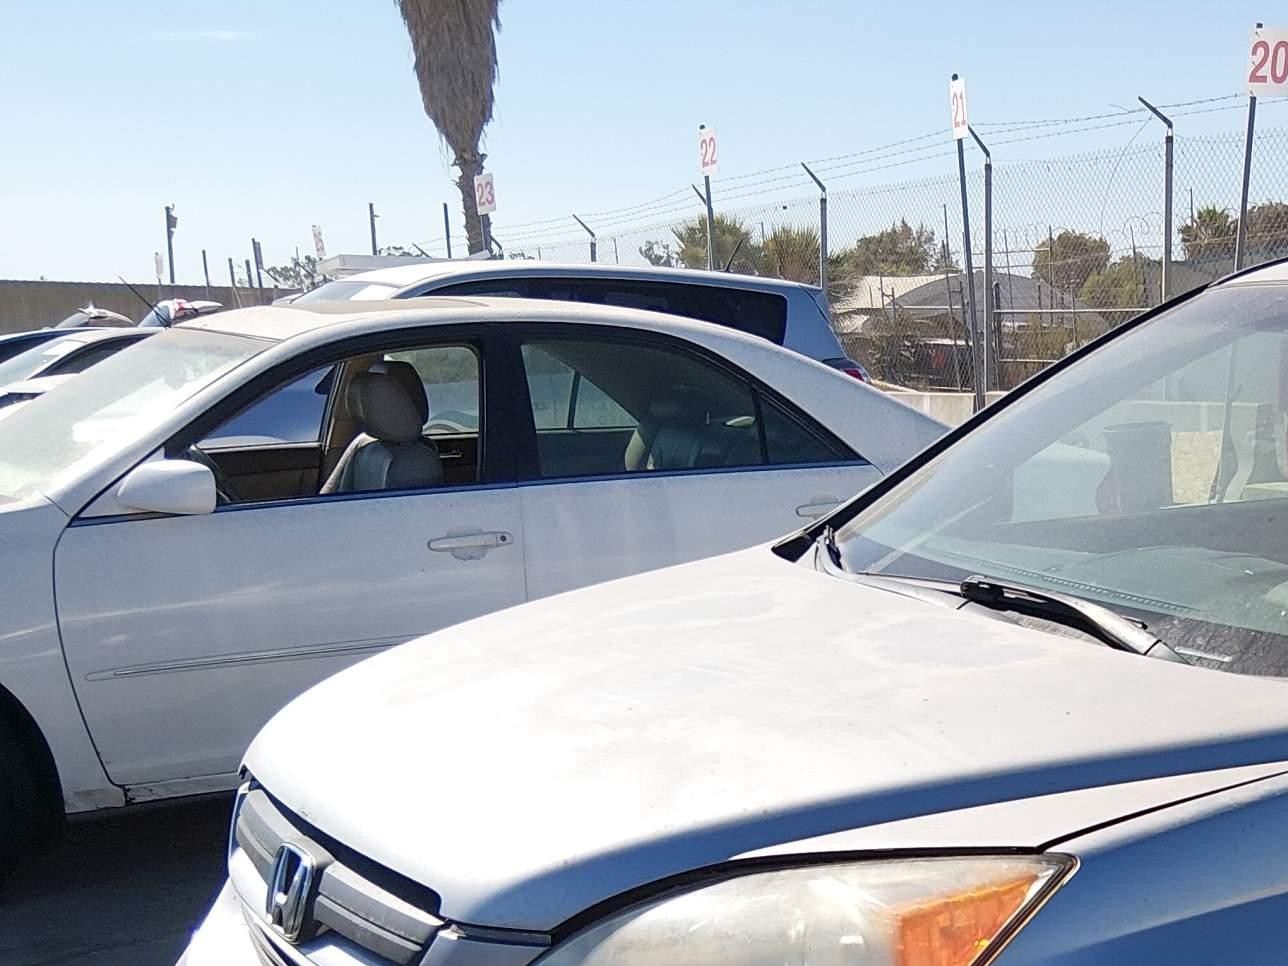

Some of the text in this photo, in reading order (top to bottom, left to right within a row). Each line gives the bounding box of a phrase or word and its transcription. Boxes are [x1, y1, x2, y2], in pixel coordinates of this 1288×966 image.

[952, 90, 967, 128] 21
[700, 137, 717, 168] 22
[476, 181, 495, 207] 23
